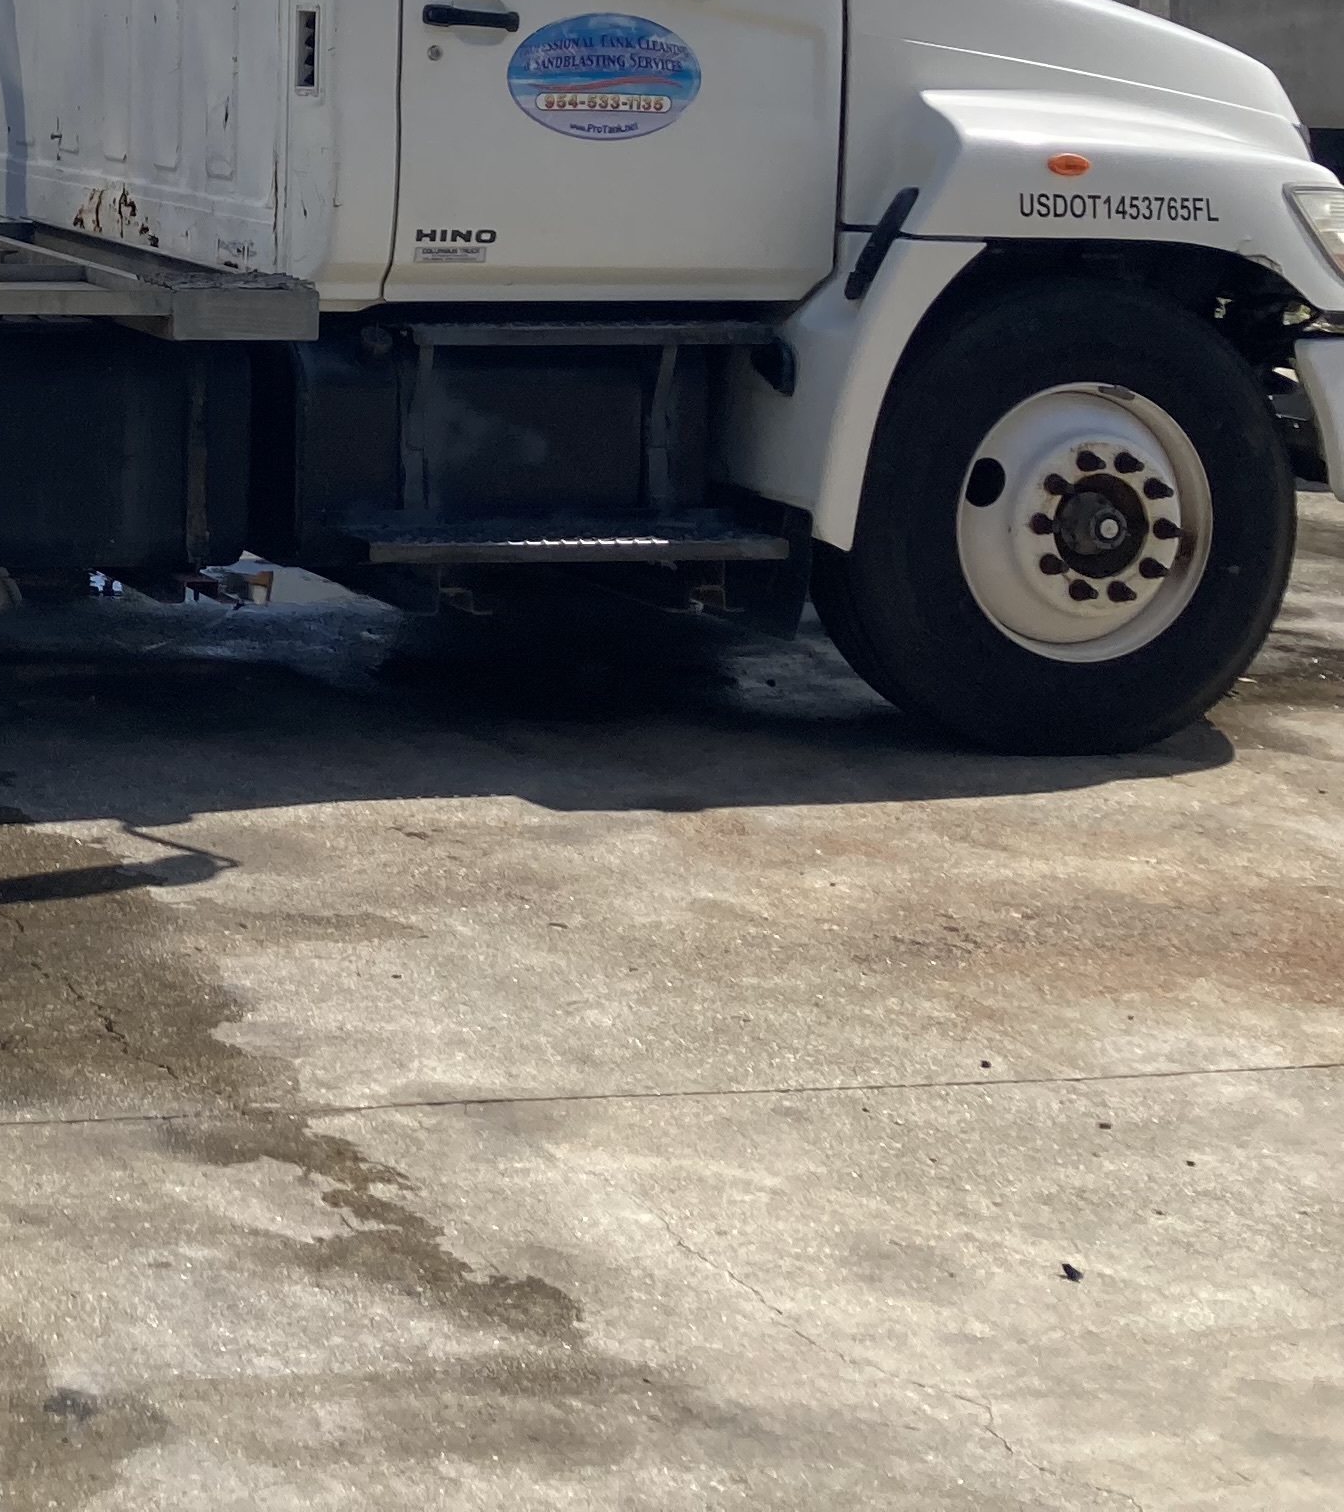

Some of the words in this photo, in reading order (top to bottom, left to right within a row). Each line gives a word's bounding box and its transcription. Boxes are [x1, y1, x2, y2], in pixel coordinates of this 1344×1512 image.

[544, 92, 664, 111] 954-533-1135
[1019, 192, 1220, 222] USDOT1453765FL
[415, 229, 497, 244] HINO
